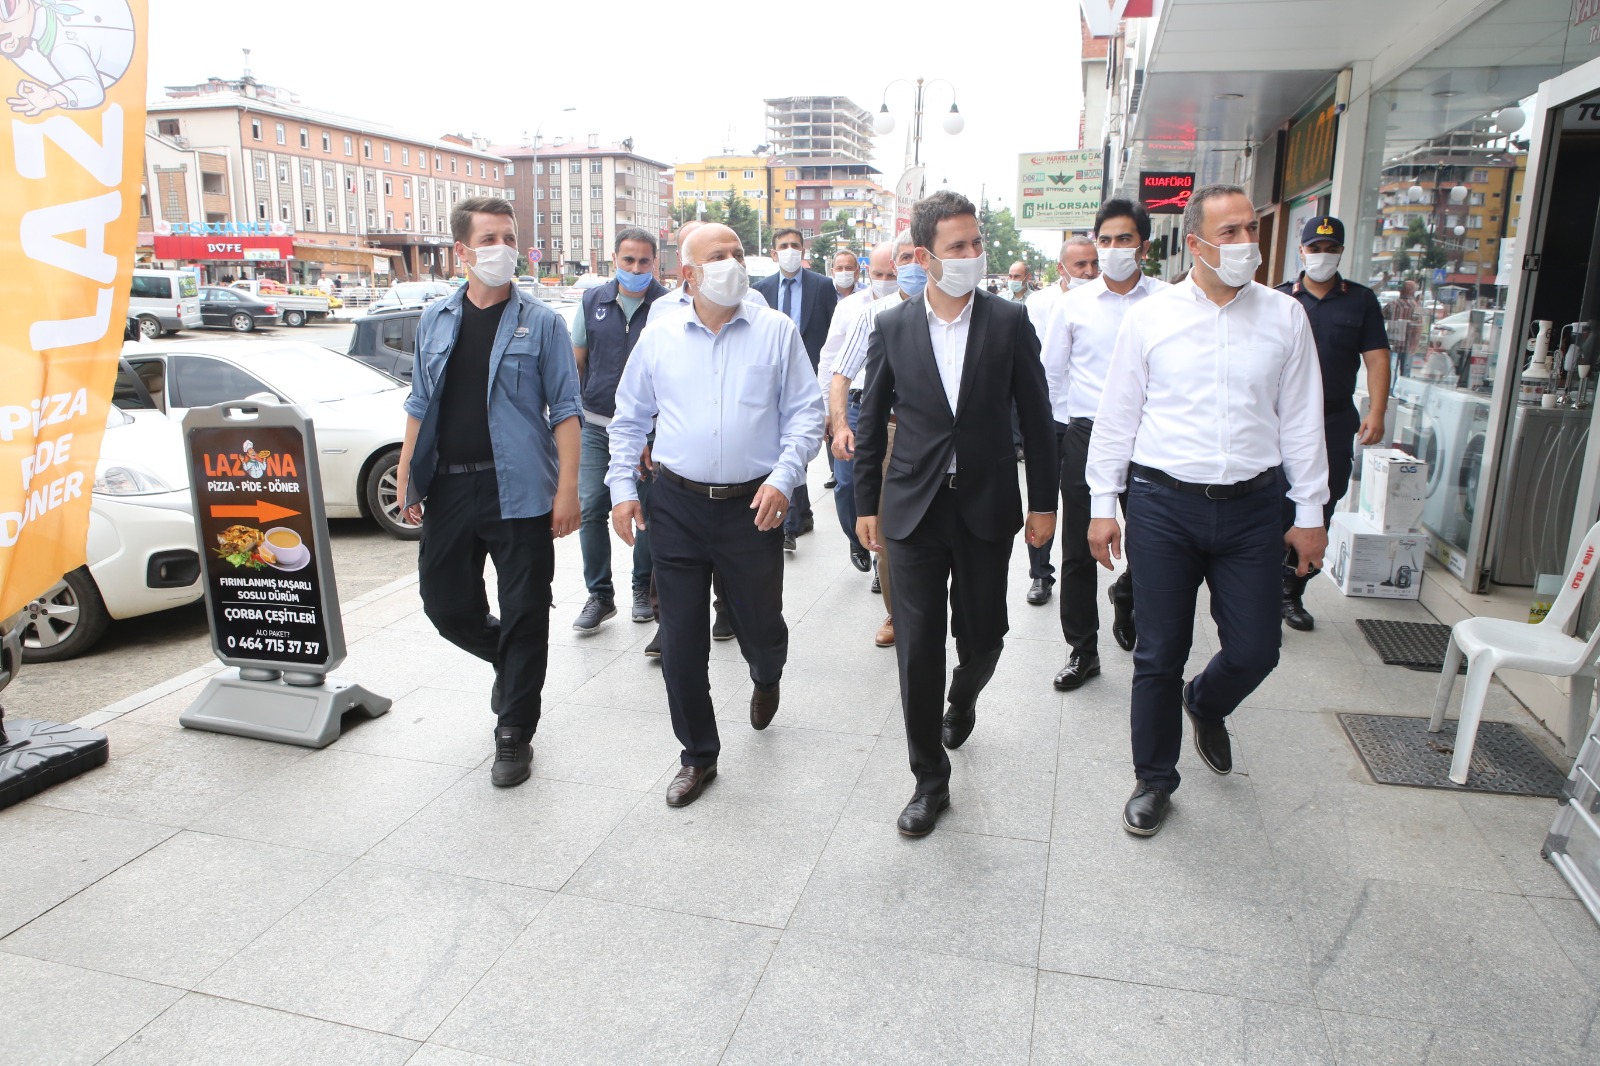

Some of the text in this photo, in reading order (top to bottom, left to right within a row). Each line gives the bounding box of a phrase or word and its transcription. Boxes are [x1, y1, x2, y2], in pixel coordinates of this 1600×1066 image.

[1144, 175, 1192, 187] KUAFÖRÜ
[172, 220, 271, 235] OSMANLI
[268, 478, 300, 493] DÖNER
[219, 577, 312, 591] FIRINLANMIŞ KAŞARLI
[237, 589, 300, 603] SOSLU DÜRÜM
[224, 607, 316, 625] ÇORBA ÇEŞİTLERİ
[227, 635, 320, 655] 0 464 715 37 37
